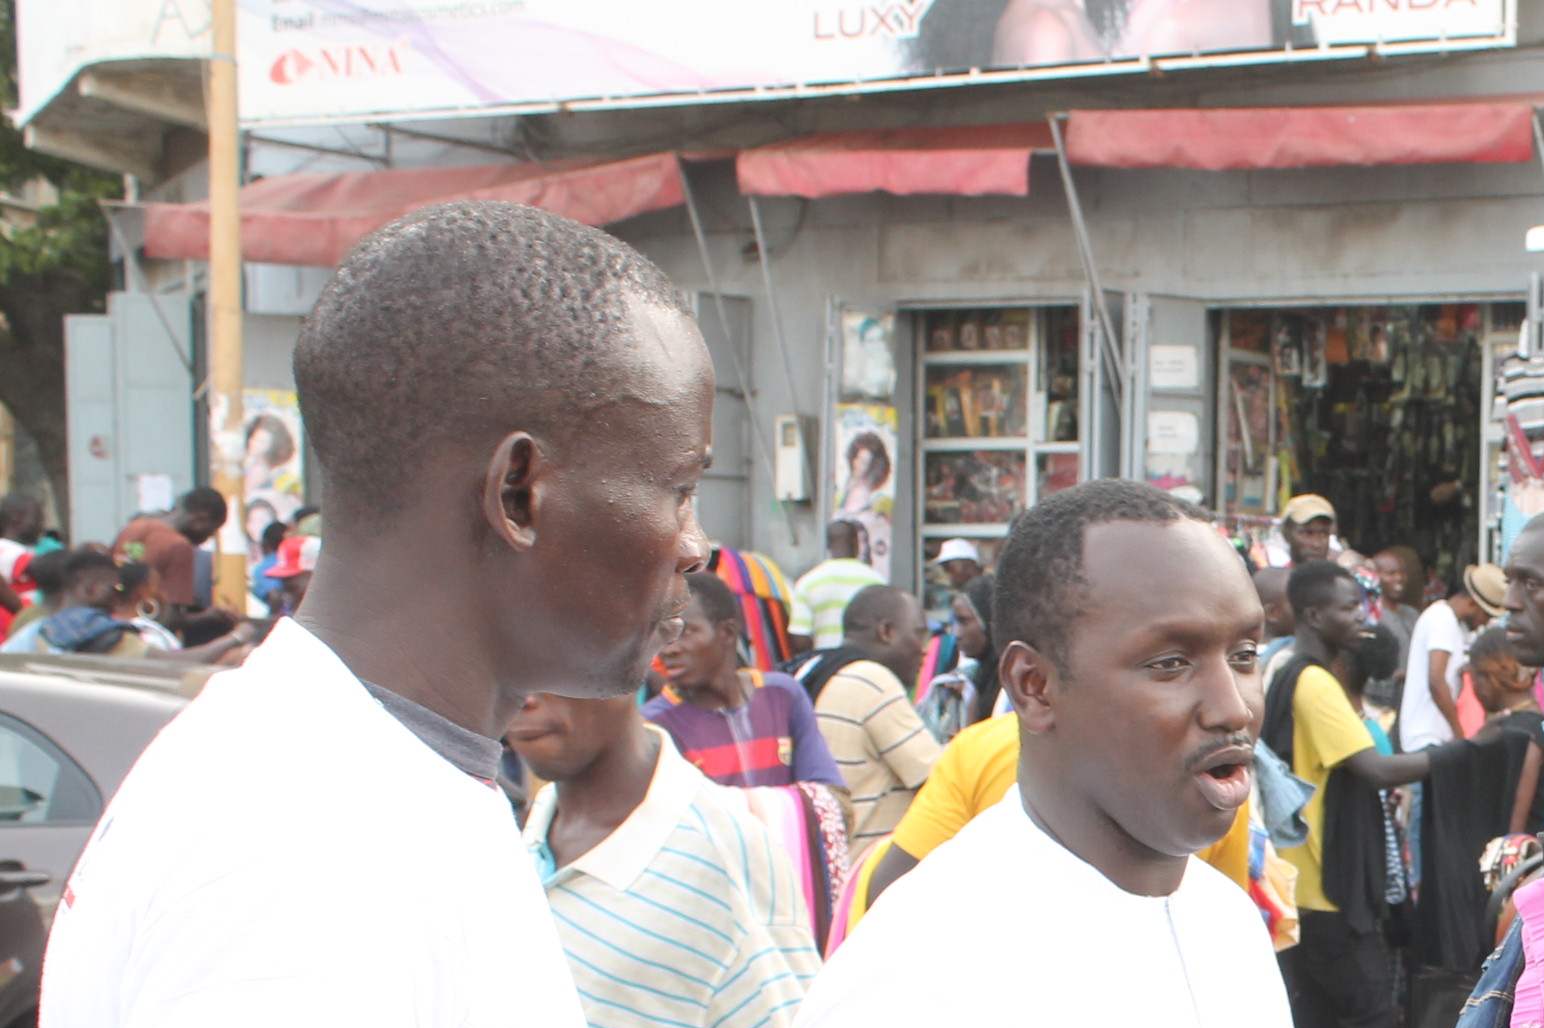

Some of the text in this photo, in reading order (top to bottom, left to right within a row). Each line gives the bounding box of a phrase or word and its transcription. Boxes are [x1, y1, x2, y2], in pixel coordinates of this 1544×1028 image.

[813, 0, 926, 40] LUXY
[1297, 0, 1477, 17] RAN
[318, 45, 403, 78] NINA
